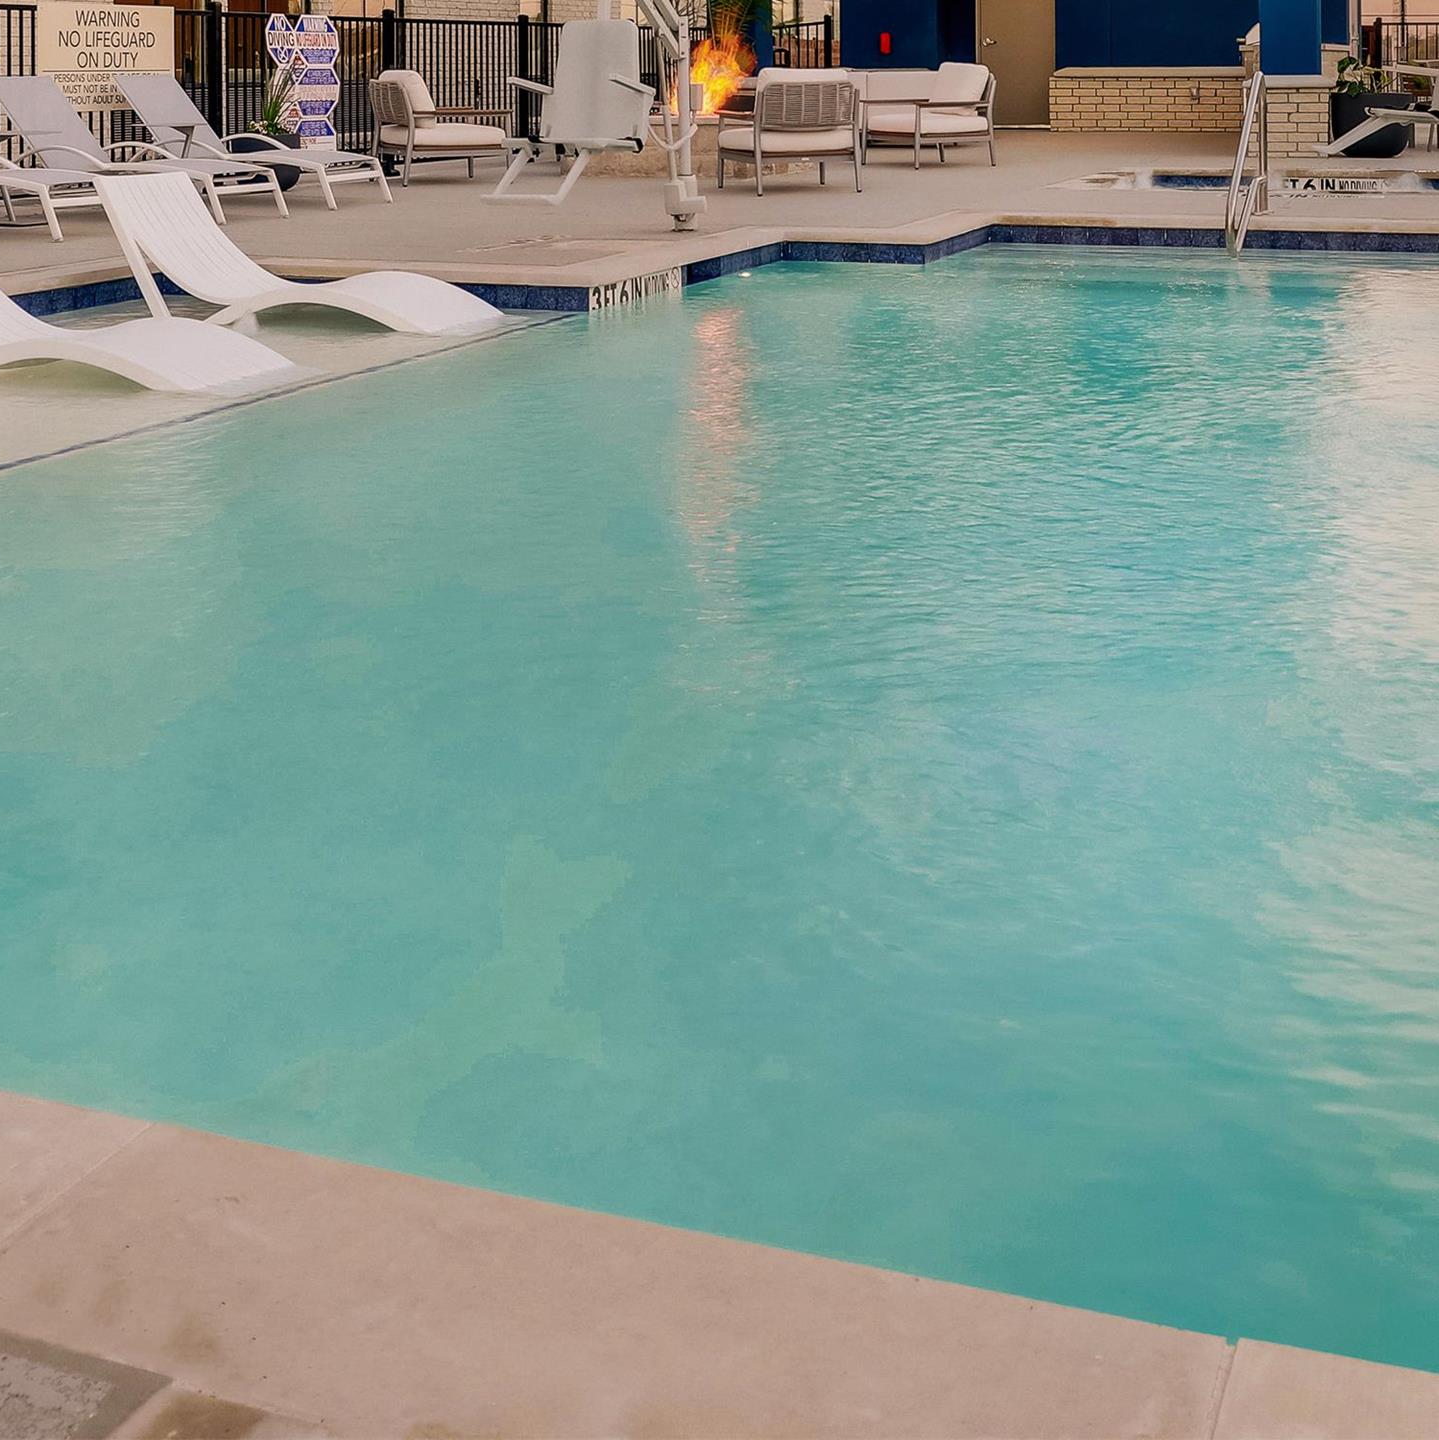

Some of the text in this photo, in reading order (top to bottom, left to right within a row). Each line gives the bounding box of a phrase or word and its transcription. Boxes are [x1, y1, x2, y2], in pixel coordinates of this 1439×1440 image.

[75, 10, 140, 28] WARNING
[274, 16, 286, 31] NO
[58, 30, 156, 48] NO LIFEGUARD
[267, 32, 295, 47] DIVING
[77, 51, 139, 68] ON DUTY
[54, 73, 85, 83] PERSONS
[86, 73, 111, 82] UNDER
[62, 84, 118, 94] MUST NOT BE IN
[67, 96, 91, 105] THOUT
[93, 95, 114, 105] ADULT
[1321, 179, 1335, 190] IN
[592, 286, 602, 310] 3
[604, 282, 617, 307] FT
[620, 279, 629, 303] 6
[631, 275, 642, 300] IN
